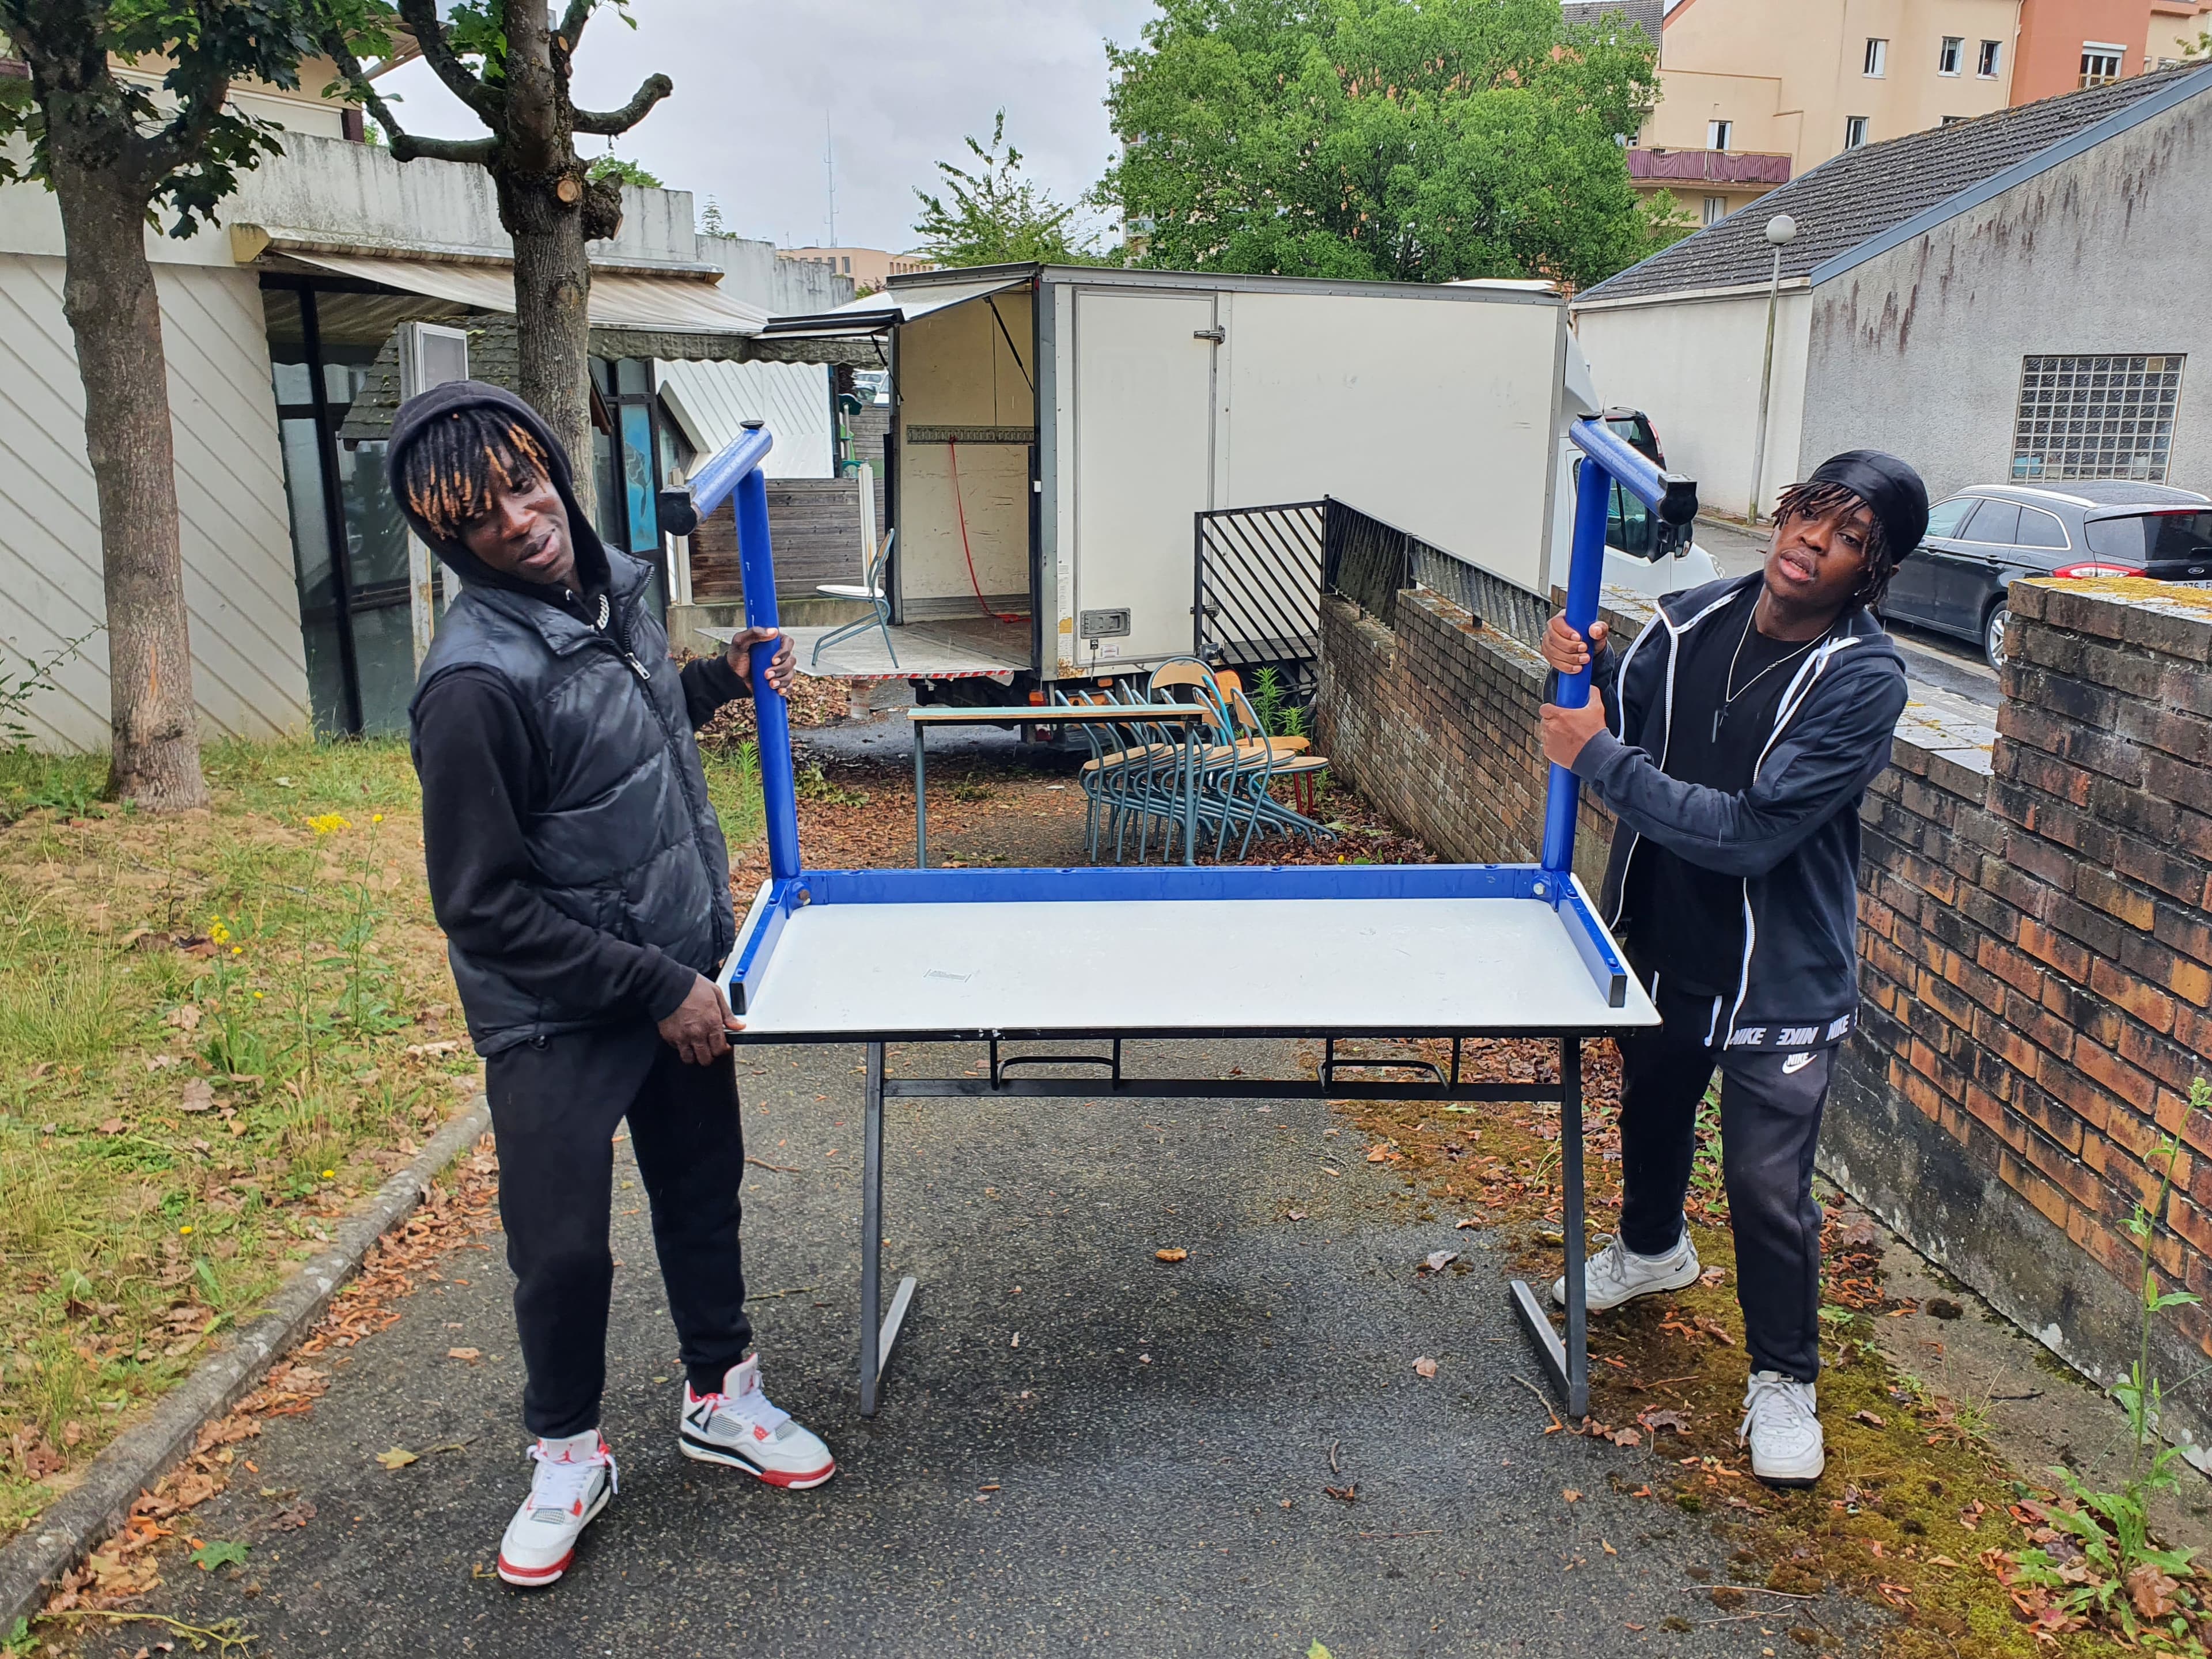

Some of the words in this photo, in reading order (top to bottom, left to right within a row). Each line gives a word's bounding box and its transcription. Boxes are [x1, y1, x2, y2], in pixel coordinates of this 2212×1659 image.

[1729, 1027, 1767, 1045] NIKE
[1775, 1027, 1820, 1046] NIKE
[1825, 1013, 1850, 1041] NIKE
[1787, 1052, 1809, 1066] NIKE
